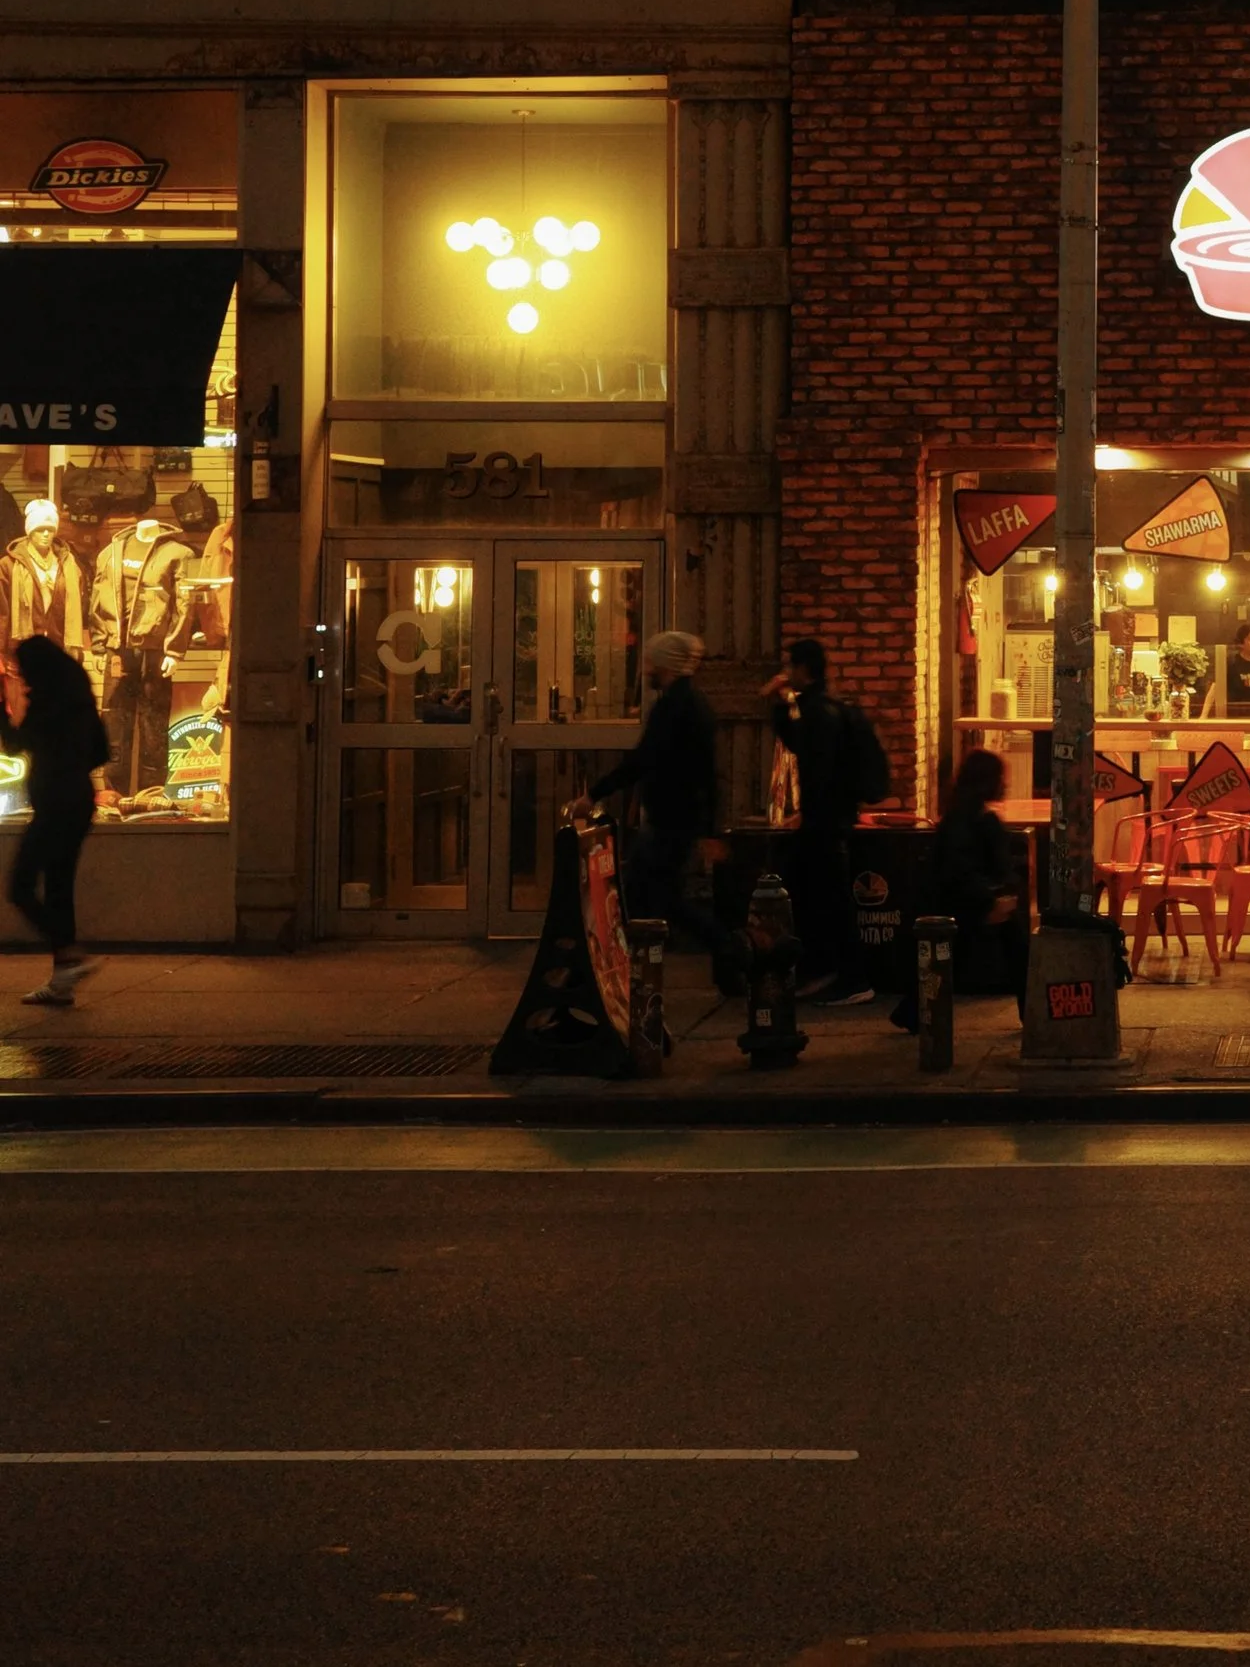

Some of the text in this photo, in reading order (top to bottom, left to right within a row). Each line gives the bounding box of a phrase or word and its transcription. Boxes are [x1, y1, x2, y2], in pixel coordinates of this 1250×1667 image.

[47, 168, 150, 187] Dickies
[0, 402, 118, 431] AVE'S
[444, 451, 550, 500] 581
[967, 504, 1030, 547] LAFFA
[1143, 510, 1223, 549] SHAWARMA
[1187, 768, 1242, 808] SWEETS
